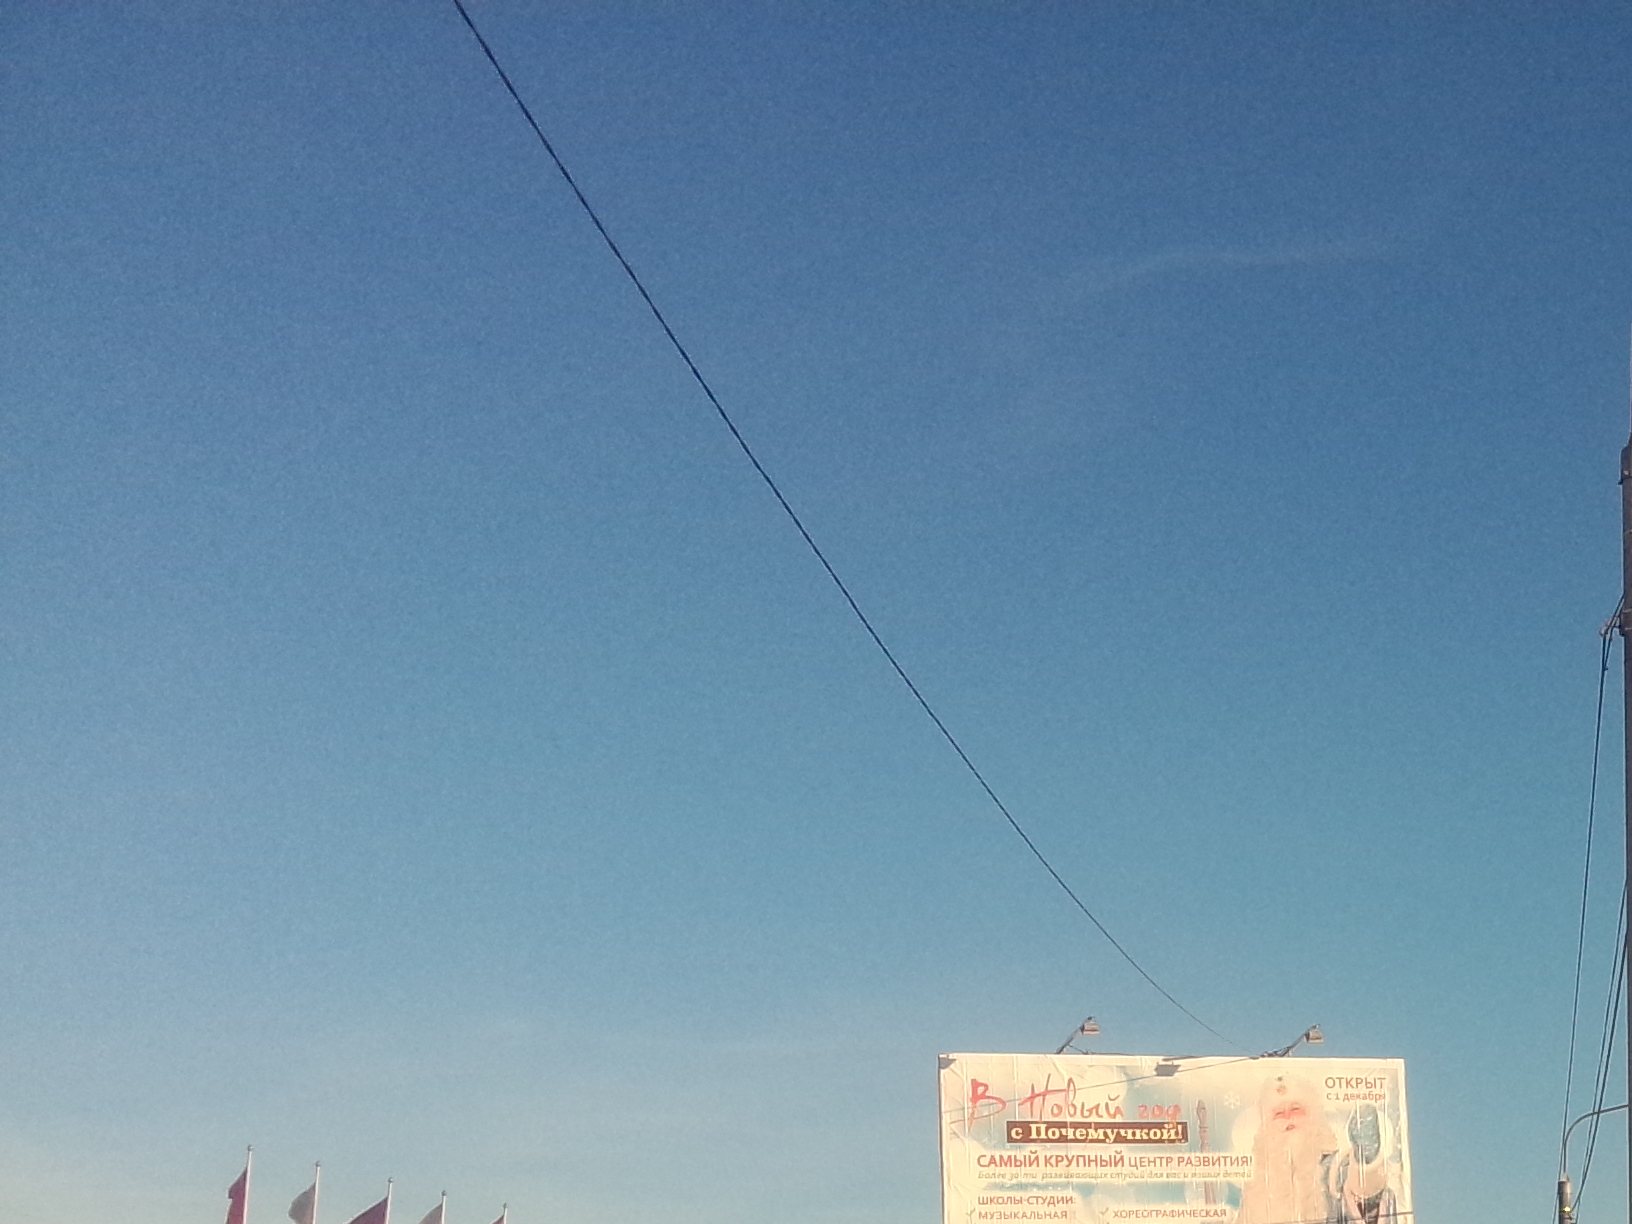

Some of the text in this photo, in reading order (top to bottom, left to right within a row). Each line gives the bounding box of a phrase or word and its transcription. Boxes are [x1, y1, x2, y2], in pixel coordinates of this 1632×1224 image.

[1325, 1077, 1386, 1089] ОТКРЫТ
[967, 1078, 1007, 1131] В
[1018, 1073, 1124, 1120] Новый
[1010, 1123, 1183, 1143] с Почемучкой!
[977, 1150, 1253, 1170] САМЫЙ КРУПНЫЙ ЦЕНТР РАЗВИТИЯ!
[978, 1211, 1068, 1220] МУЗЫКАЛЬНАЯ
[1113, 1209, 1227, 1219] ХОРЕОГРАФИЧЕСКАЯ
